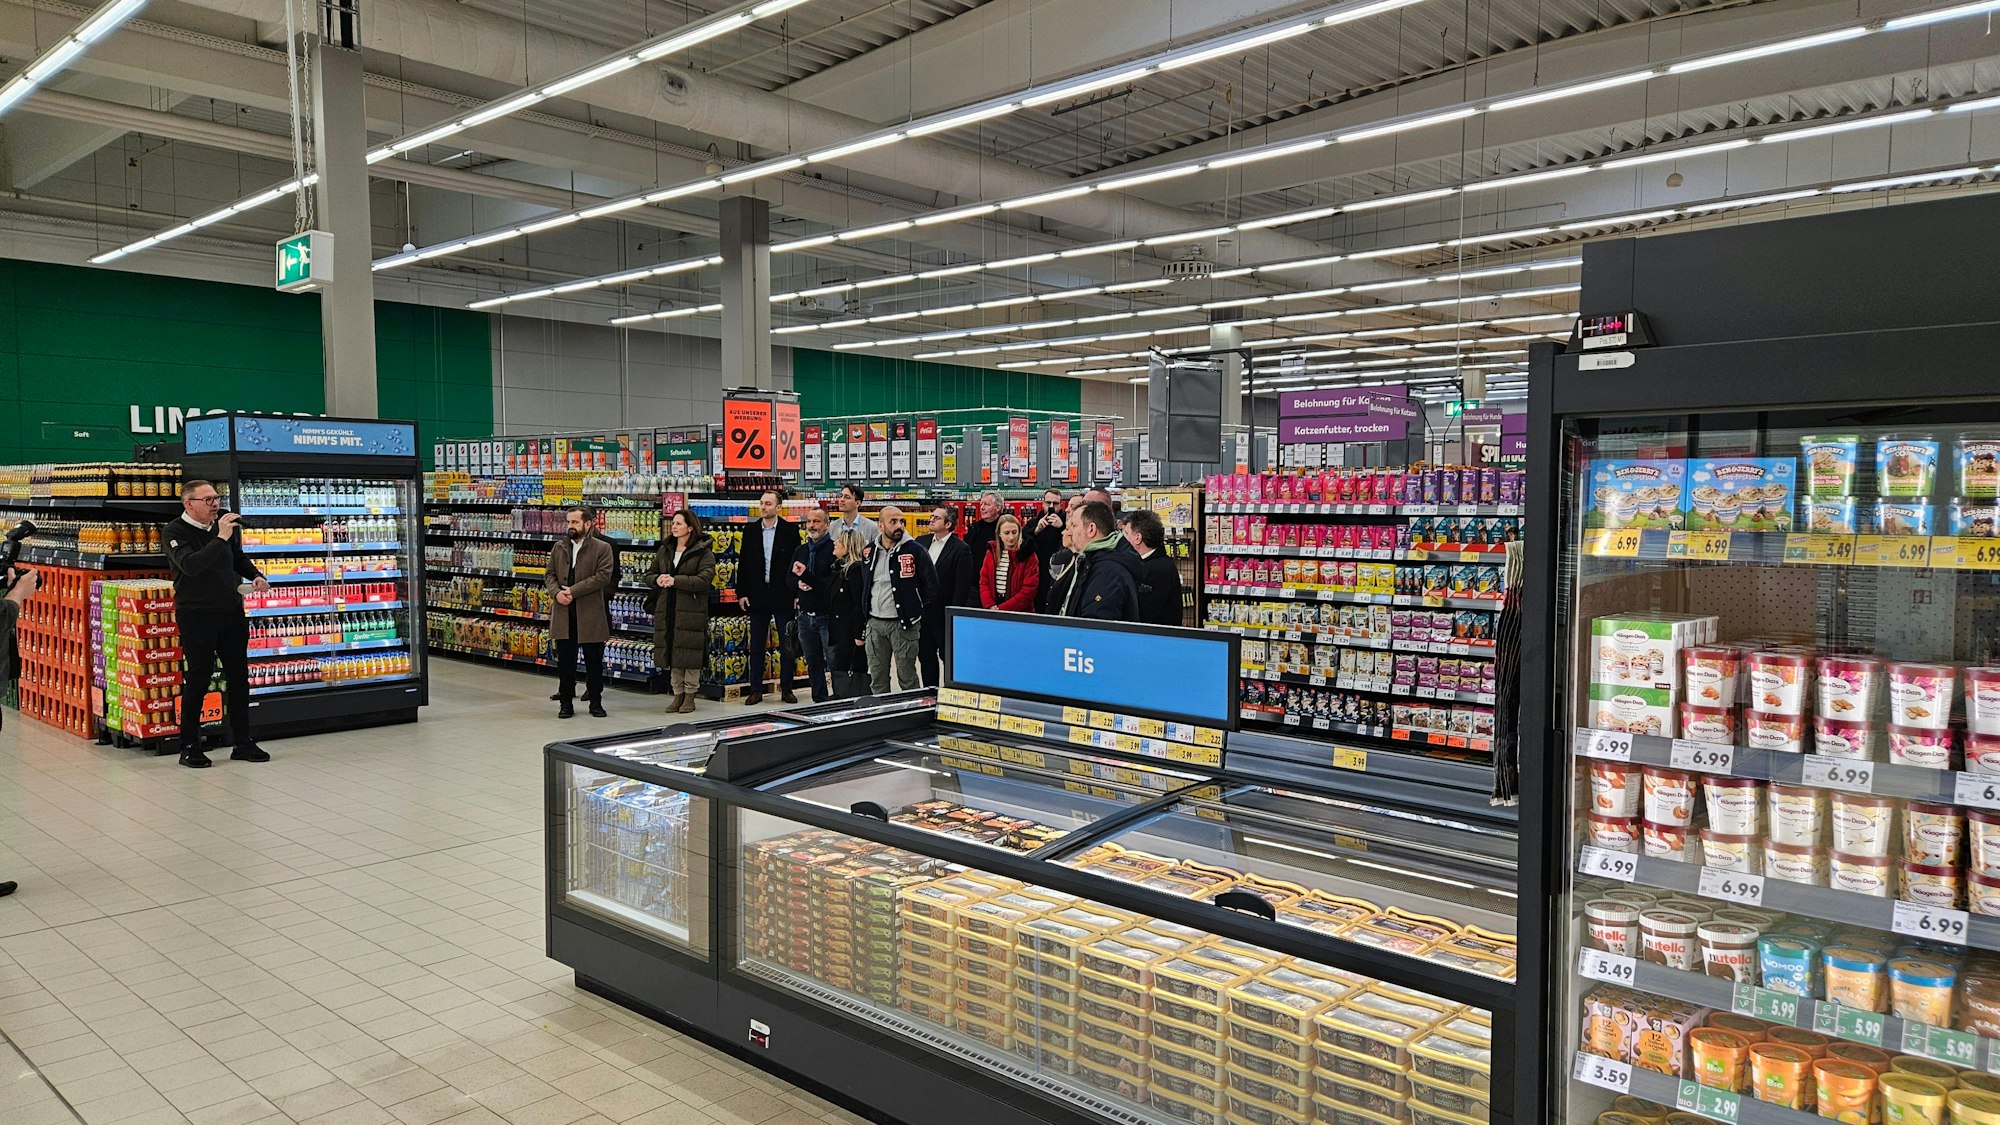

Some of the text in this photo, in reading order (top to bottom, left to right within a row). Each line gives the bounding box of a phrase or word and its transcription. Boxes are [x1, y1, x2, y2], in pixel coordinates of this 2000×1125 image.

[1294, 398, 1340, 409] Belohnung
[1342, 396, 1356, 406] für
[1370, 403, 1417, 417] Belohnung für Katzen
[73, 430, 90, 438] Soft
[327, 428, 354, 436] GEKÜHLT.
[1294, 423, 1389, 435] Katzenfutter, trocken
[293, 435, 363, 447] NIMM'S MIT.
[731, 428, 765, 460] %
[1617, 536, 1638, 551] 6.99
[1705, 539, 1728, 554] 6.99
[1826, 542, 1851, 558] 3.49
[1899, 544, 1926, 560] 6.99
[144, 597, 174, 610] GÖNRGY
[145, 622, 176, 634] GÖNRGY
[145, 648, 176, 659] GÖNRGY
[1064, 647, 1095, 674] Eis
[145, 672, 176, 684] GÖNRGY
[147, 697, 174, 709] GÖNRG
[1594, 738, 1630, 755] 6.99
[1353, 756, 1365, 768] 3.99
[1692, 750, 1730, 768] 6.99
[1827, 766, 1870, 785] 6.99
[1600, 857, 1634, 875] 6.99
[1721, 879, 1760, 899] 6.99
[1919, 915, 1964, 935] 6.99
[1589, 927, 1627, 942] nutella
[1645, 937, 1686, 953] nutella
[1708, 951, 1752, 965] nutella
[1598, 960, 1633, 979] 5.49
[1771, 1000, 1795, 1019] 5.99
[1855, 1018, 1881, 1039] 5.99
[1946, 1038, 1974, 1060] 5.99
[1593, 1064, 1629, 1086] 3.59
[1706, 1062, 1723, 1073] Bio
[1766, 1077, 1784, 1089] Bio
[1678, 1098, 1693, 1108] BIO
[1714, 1097, 1737, 1118] 2.99
